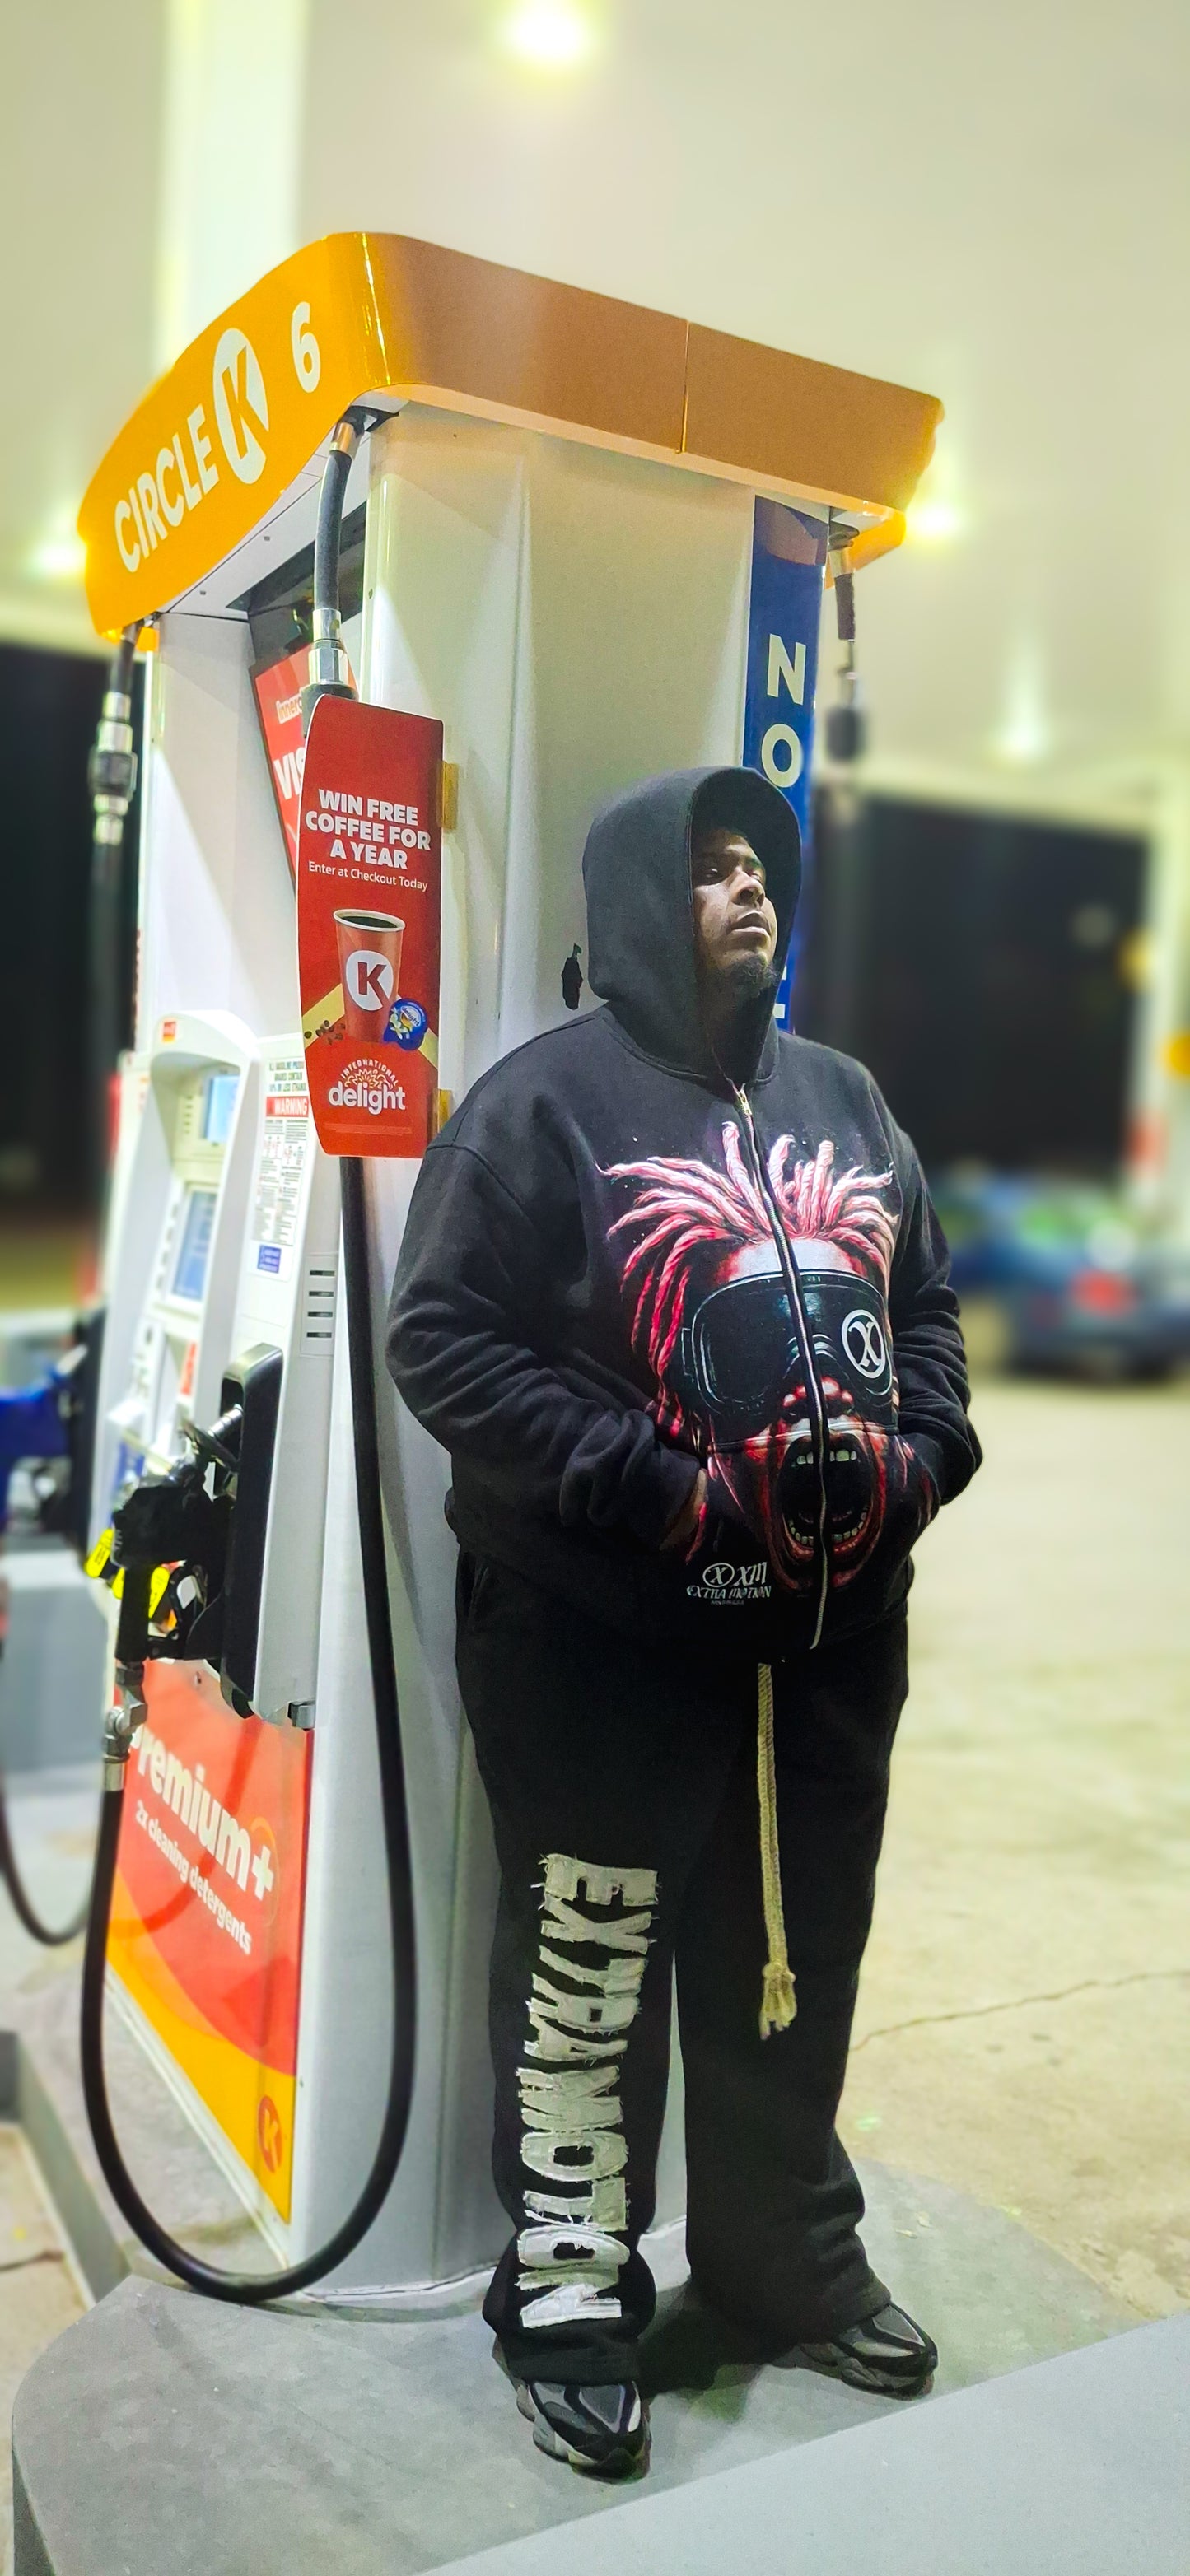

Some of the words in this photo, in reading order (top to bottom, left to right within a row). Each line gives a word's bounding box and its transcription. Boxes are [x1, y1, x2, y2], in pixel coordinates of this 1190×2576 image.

[114, 403, 219, 573] CIRCLE
[217, 336, 269, 473] K
[290, 300, 322, 394] 6
[318, 788, 363, 817] WIN
[366, 798, 418, 826] FREE
[306, 810, 385, 843] COFFEE
[389, 826, 432, 851] FOR
[329, 838, 347, 860] A
[349, 841, 408, 870] YEAR
[308, 860, 336, 876] Enter
[338, 867, 348, 878] at
[350, 868, 397, 886] Checkout
[399, 875, 428, 893] Today
[354, 957, 391, 1009] K
[340, 1059, 399, 1087] INTERNATIONAL
[274, 1097, 308, 1116] WARNING
[328, 1081, 406, 1115] delight
[846, 1316, 881, 1376] X
[148, 1817, 189, 1884] cleaning
[189, 1865, 253, 1957] detergents
[259, 2099, 282, 2171] K
